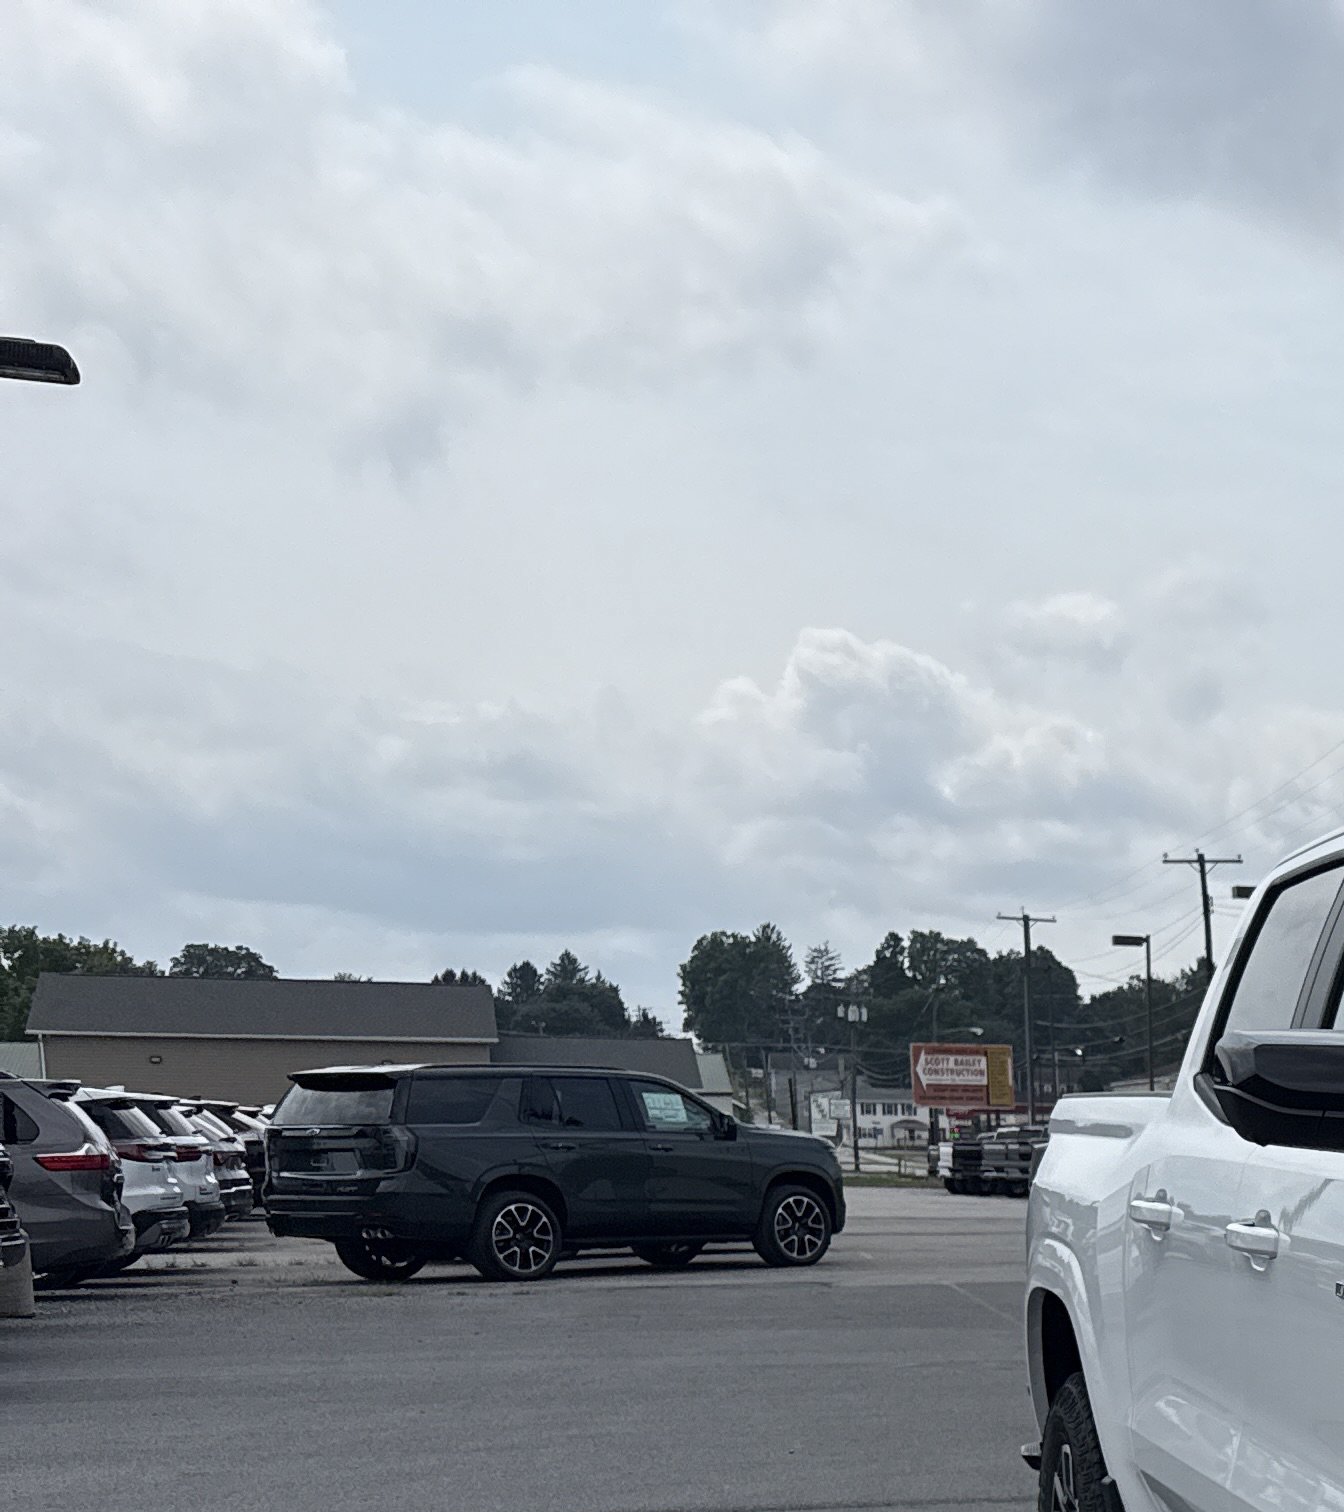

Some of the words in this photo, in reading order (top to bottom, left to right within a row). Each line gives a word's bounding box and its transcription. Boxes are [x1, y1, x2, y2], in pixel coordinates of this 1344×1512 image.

[924, 1057, 950, 1066] SCOTT
[954, 1057, 982, 1066] BAILEY
[922, 1067, 985, 1077] CONSTRUCTION
